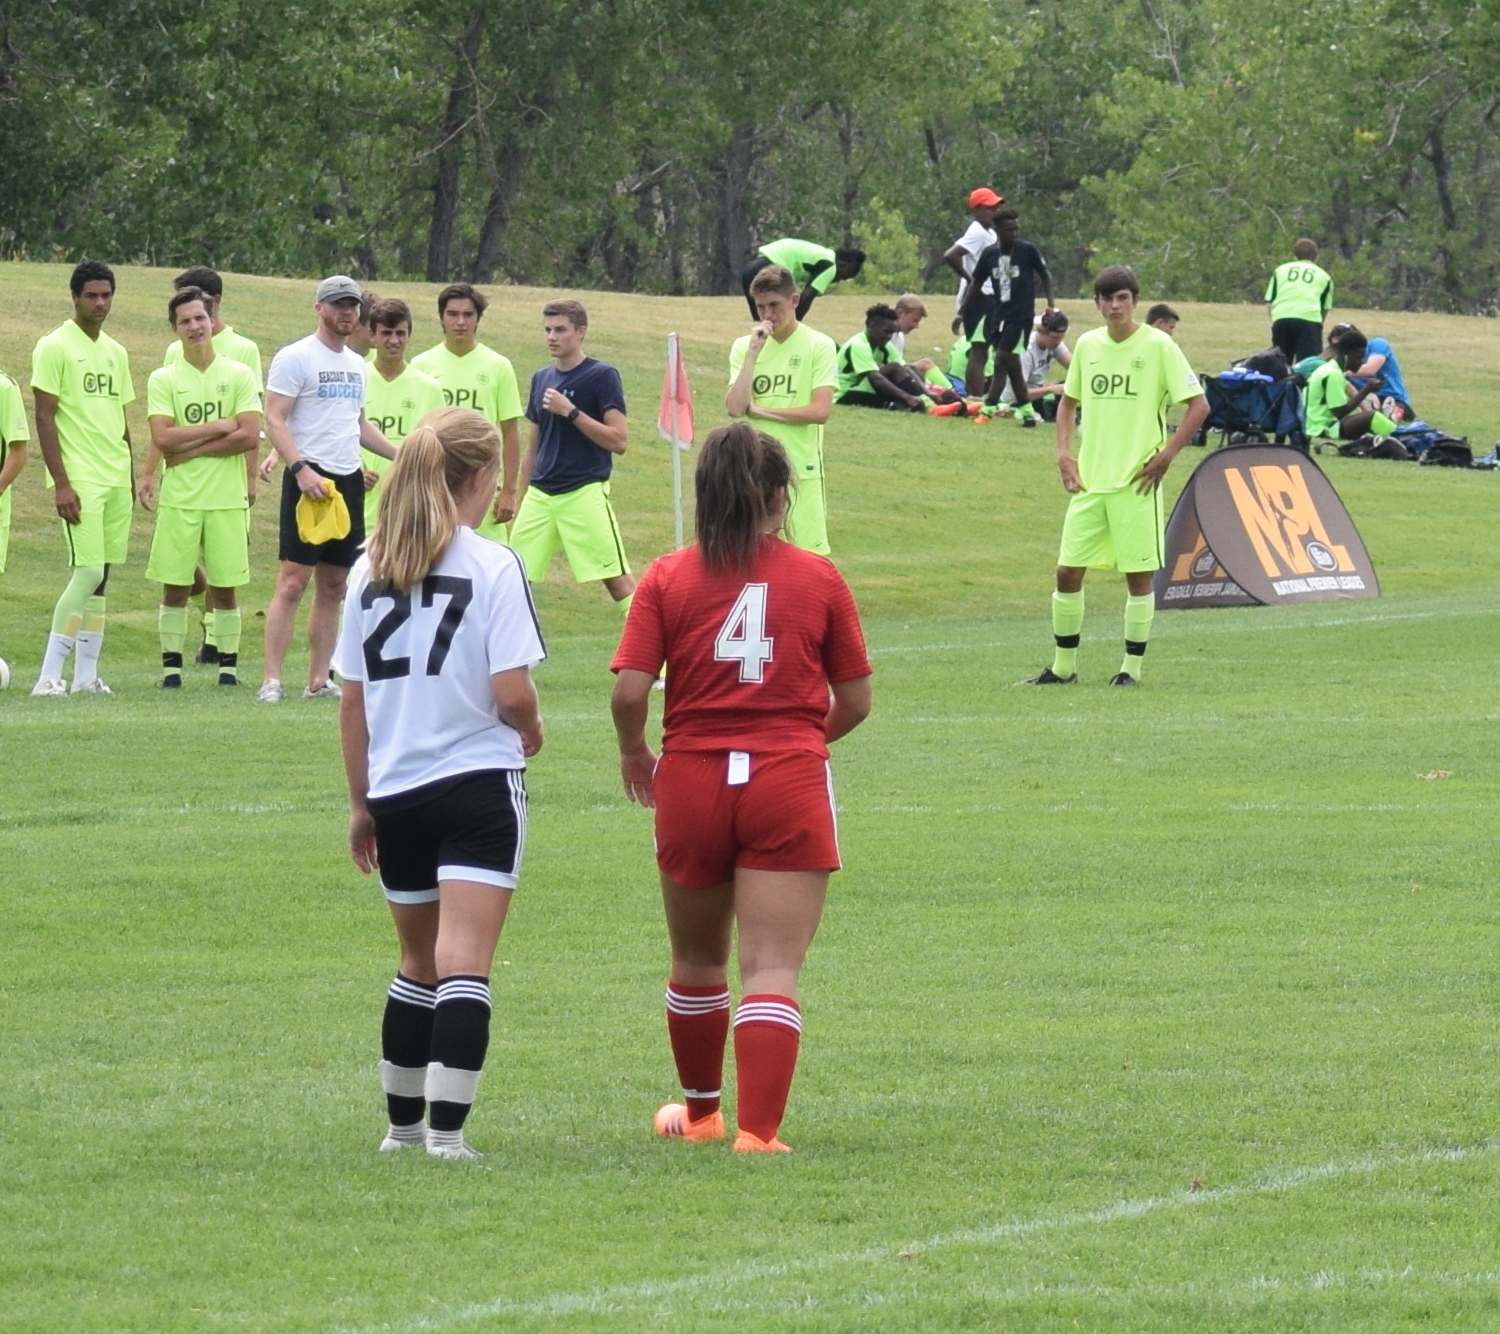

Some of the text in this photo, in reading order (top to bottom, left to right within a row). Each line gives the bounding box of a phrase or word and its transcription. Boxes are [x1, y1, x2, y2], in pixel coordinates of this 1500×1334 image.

[1287, 266, 1316, 284] 66
[83, 372, 120, 397] OPL
[752, 374, 798, 395] OPL
[1090, 374, 1138, 396] OPL
[184, 400, 227, 424] OPL
[360, 574, 474, 683] 27
[713, 582, 775, 684] 4
